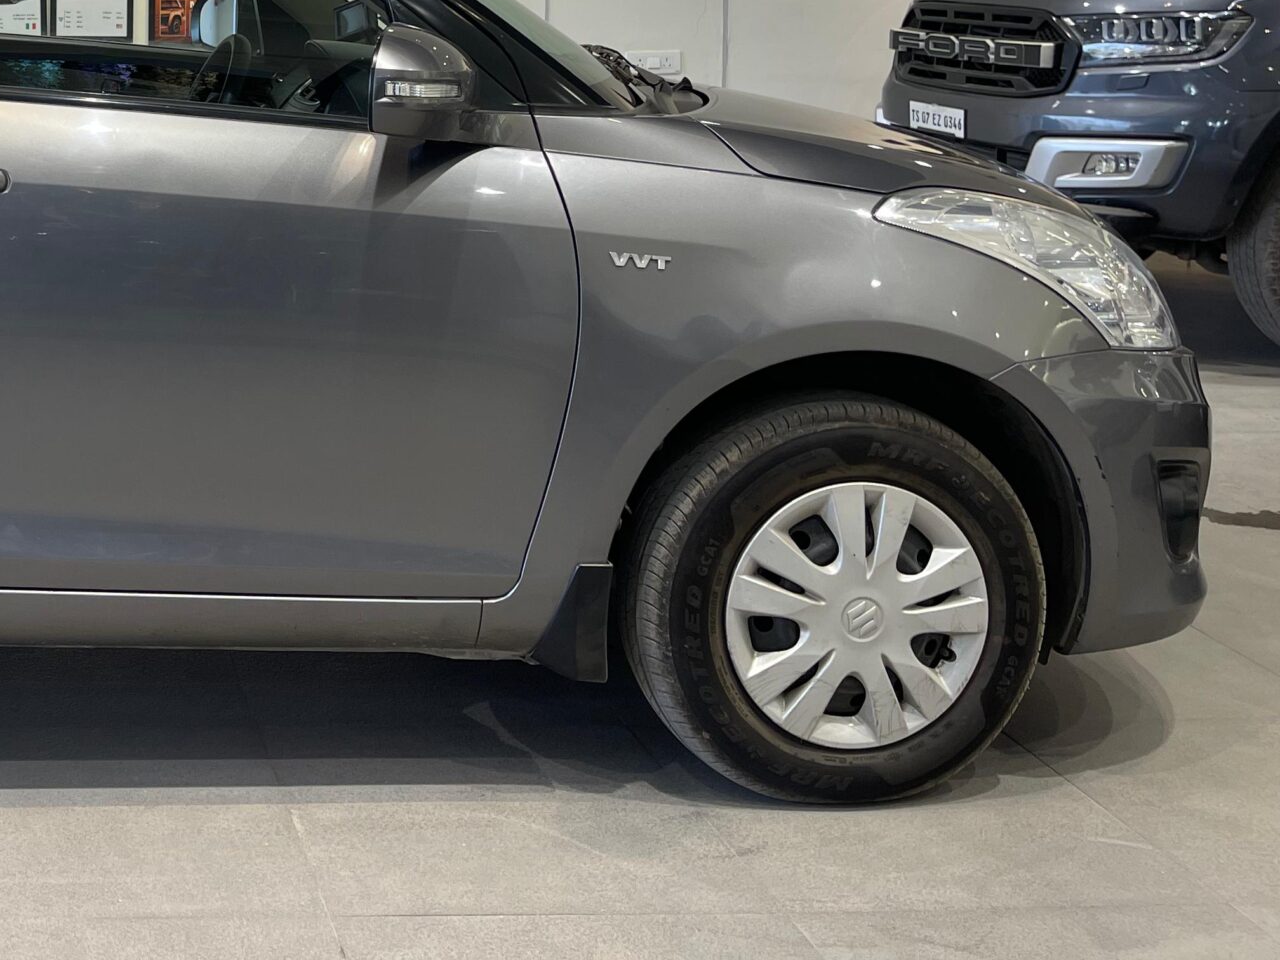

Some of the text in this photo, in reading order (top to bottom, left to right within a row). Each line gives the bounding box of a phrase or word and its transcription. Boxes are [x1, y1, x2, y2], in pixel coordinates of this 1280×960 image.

[890, 29, 1054, 68] FORD
[911, 109, 962, 130] TS 07 EZ 0346
[609, 251, 672, 270] VVT
